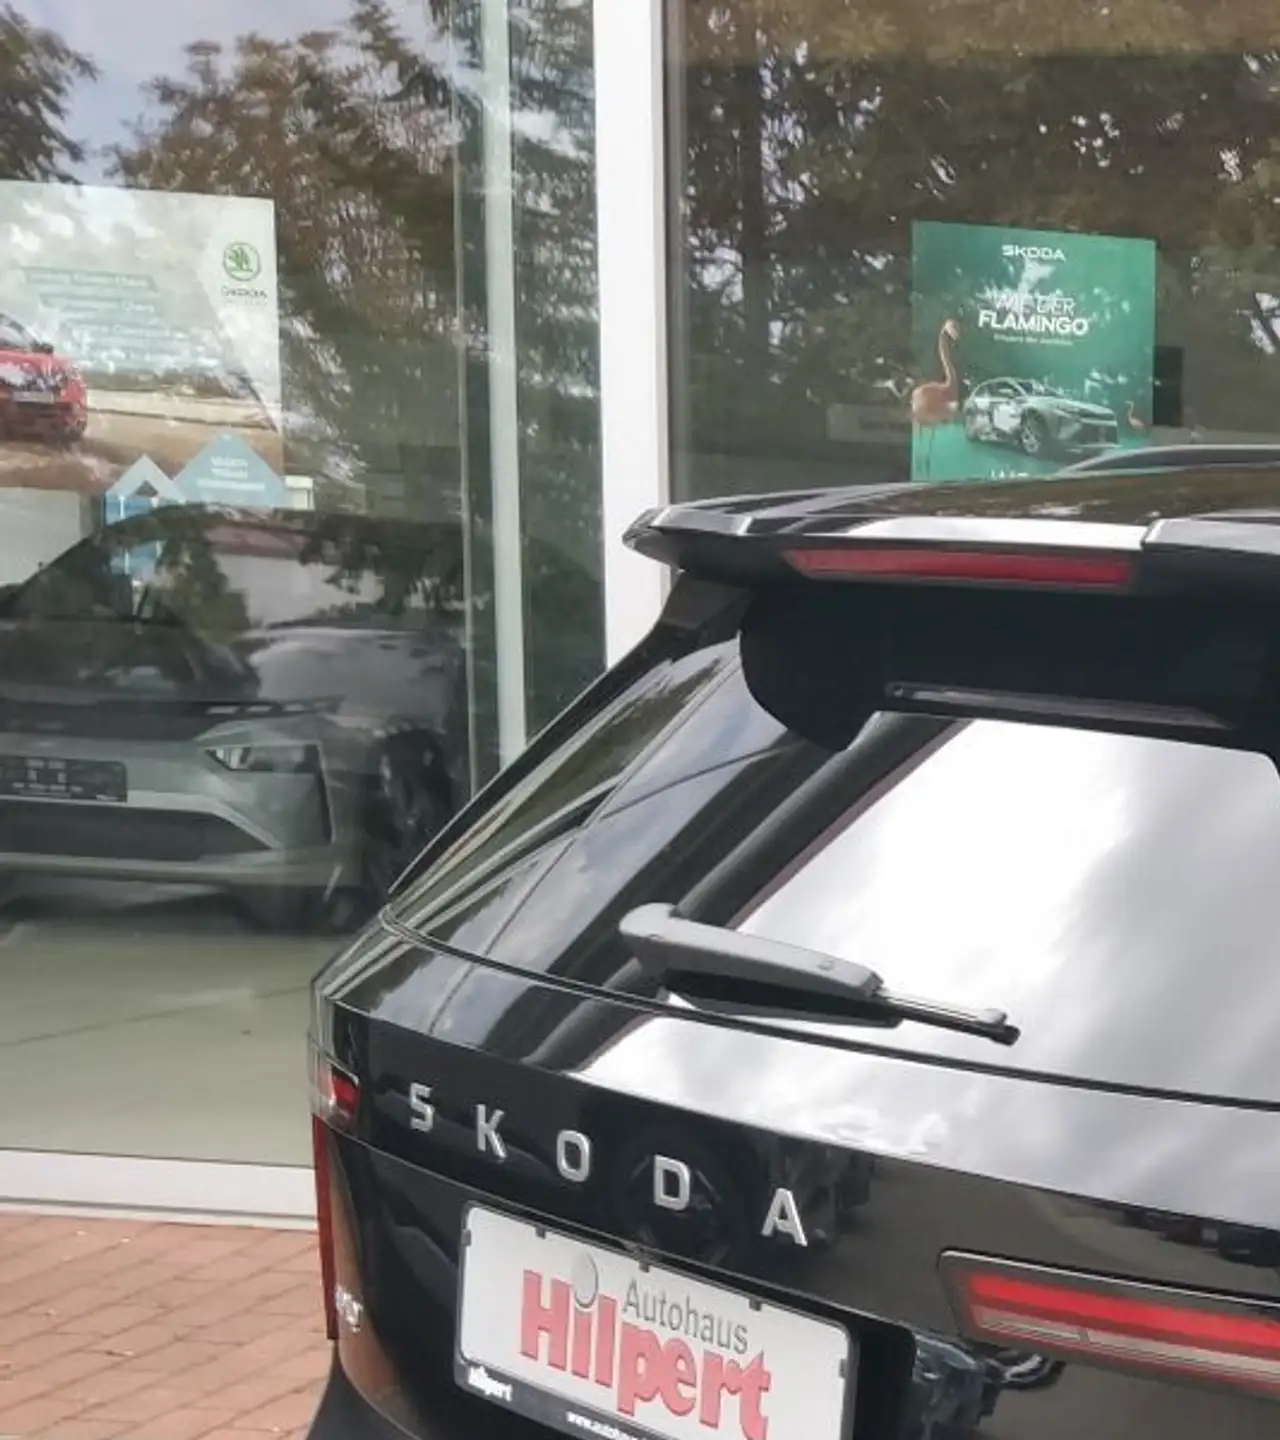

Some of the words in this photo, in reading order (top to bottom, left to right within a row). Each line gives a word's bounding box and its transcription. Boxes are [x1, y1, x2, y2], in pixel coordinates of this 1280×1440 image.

[978, 309, 1089, 336] FLAMINGO
[409, 1082, 808, 1247] SKODA
[622, 1279, 750, 1356] Autohaus
